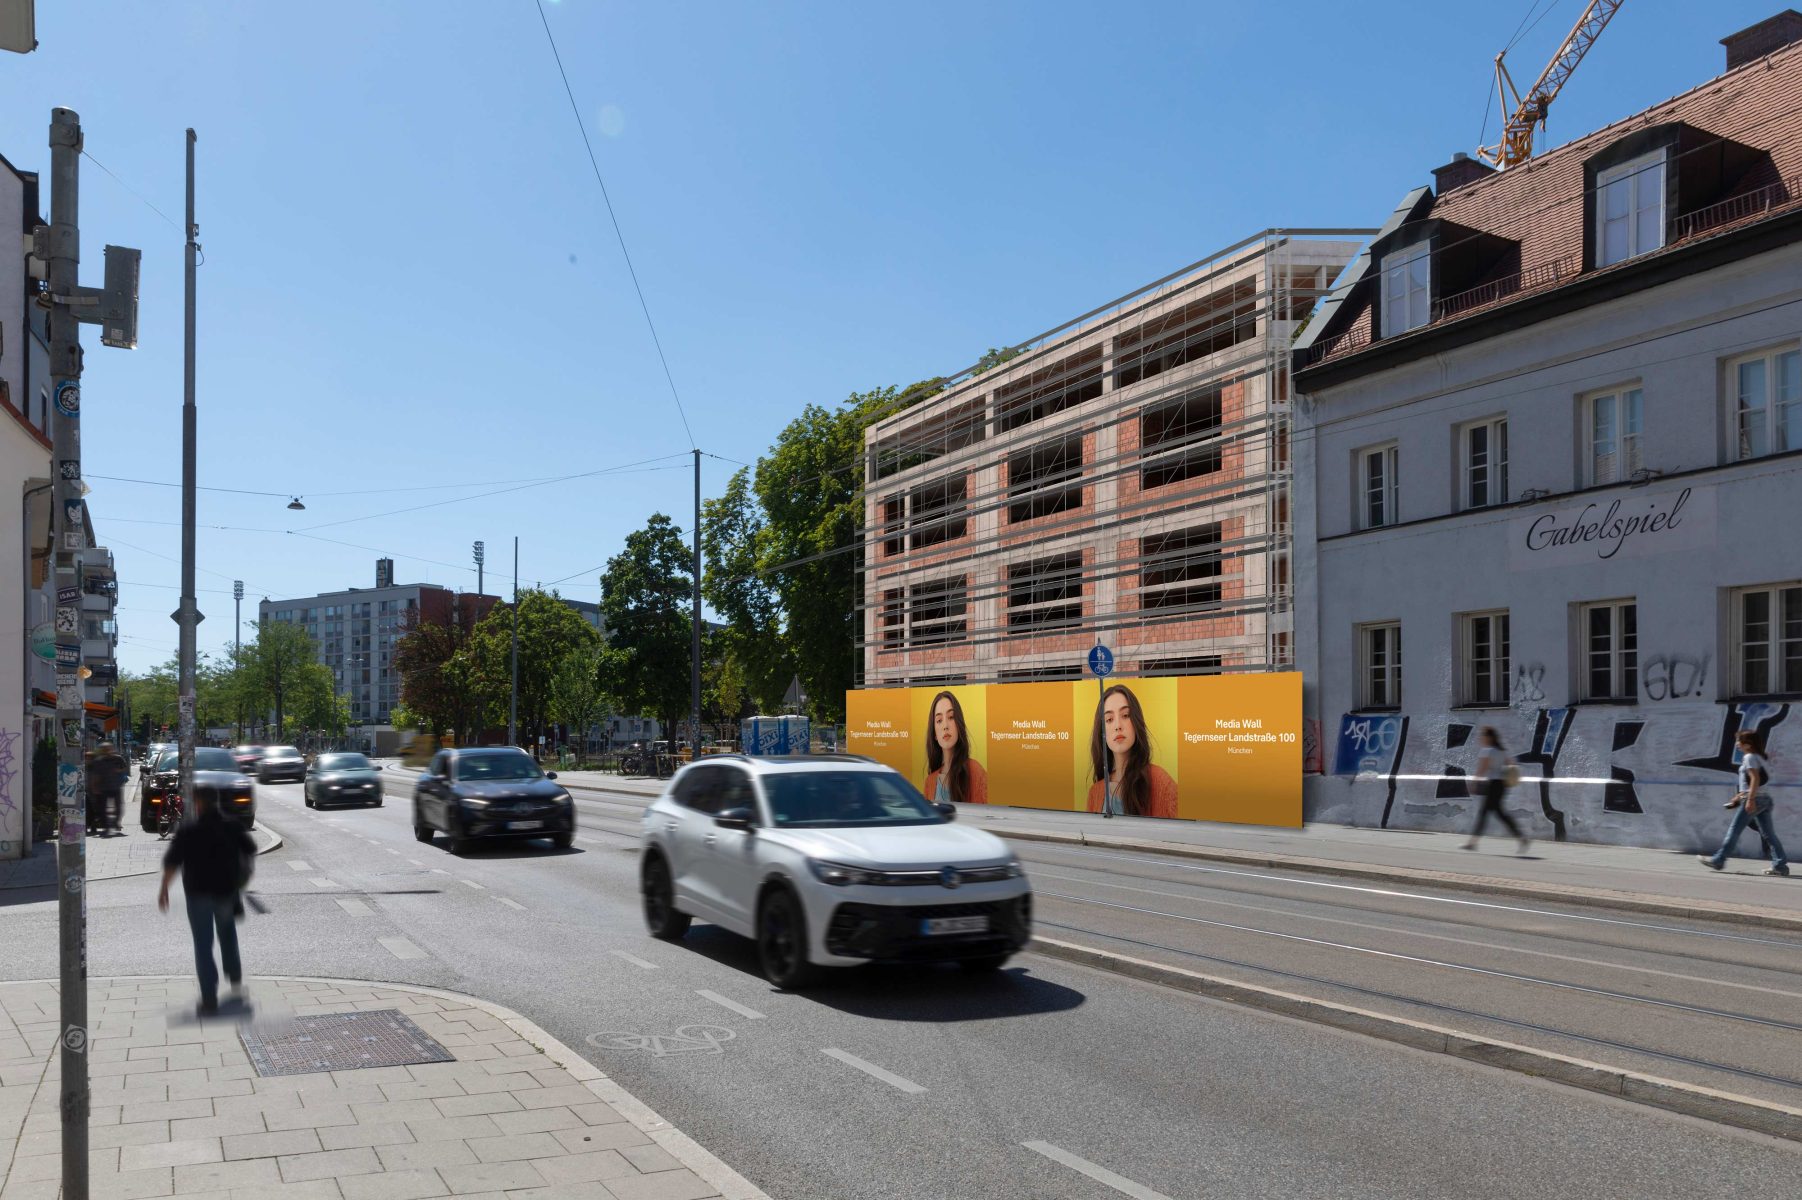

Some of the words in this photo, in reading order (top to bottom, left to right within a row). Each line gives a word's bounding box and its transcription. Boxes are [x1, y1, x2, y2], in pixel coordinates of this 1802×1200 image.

[1526, 487, 1692, 559] Gabelspiel
[1012, 720, 1031, 729] Media
[1032, 720, 1046, 729] Wall
[1215, 719, 1240, 729] Media
[1242, 719, 1262, 729] Wall
[991, 731, 1021, 741] Tegernseer
[1022, 731, 1056, 740] Landstraße
[1057, 731, 1069, 740] 100
[1184, 732, 1227, 744] Tegernseer
[1229, 732, 1277, 742] Landstraße
[1279, 733, 1296, 743] 100
